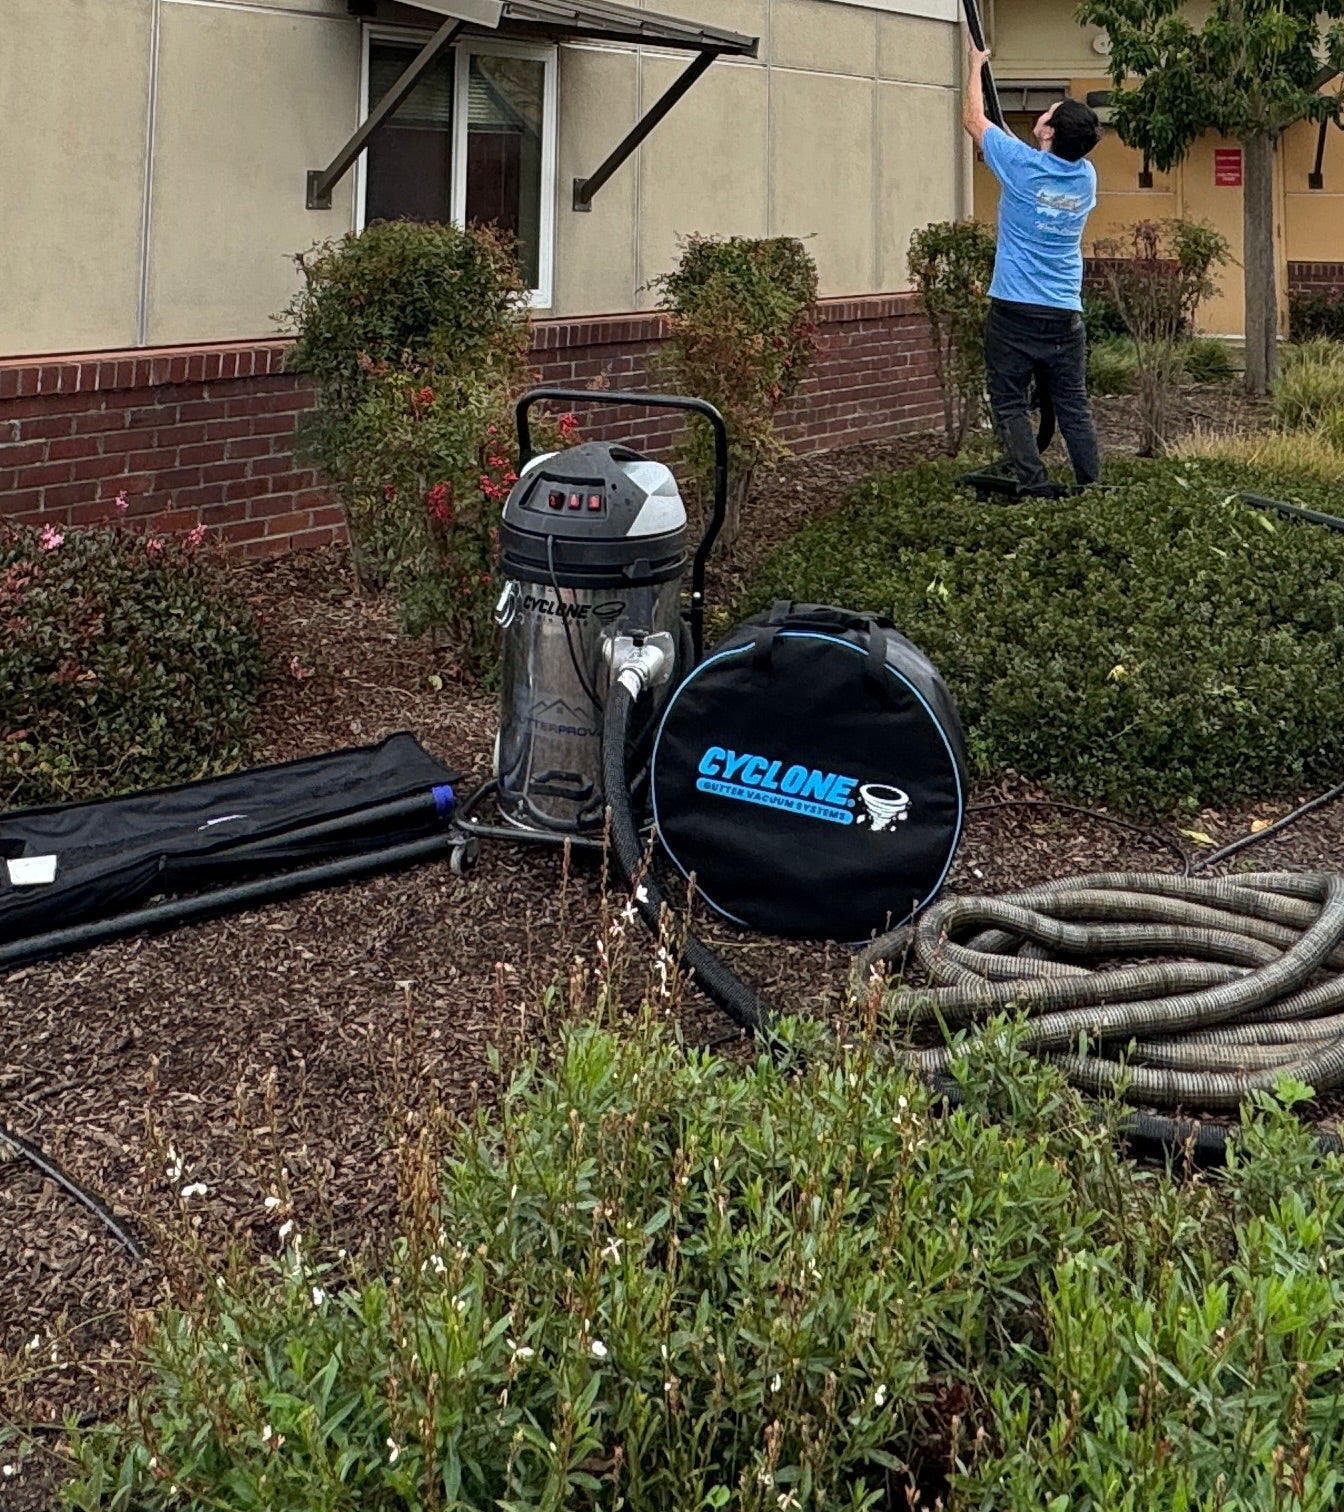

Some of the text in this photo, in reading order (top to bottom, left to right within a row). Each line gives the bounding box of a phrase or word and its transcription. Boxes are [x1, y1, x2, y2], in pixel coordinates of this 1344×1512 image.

[523, 595, 592, 619] CYCLONE
[698, 746, 859, 805] CYCLONE
[703, 781, 845, 821] GUTTER VACUUM SYSTEMS
